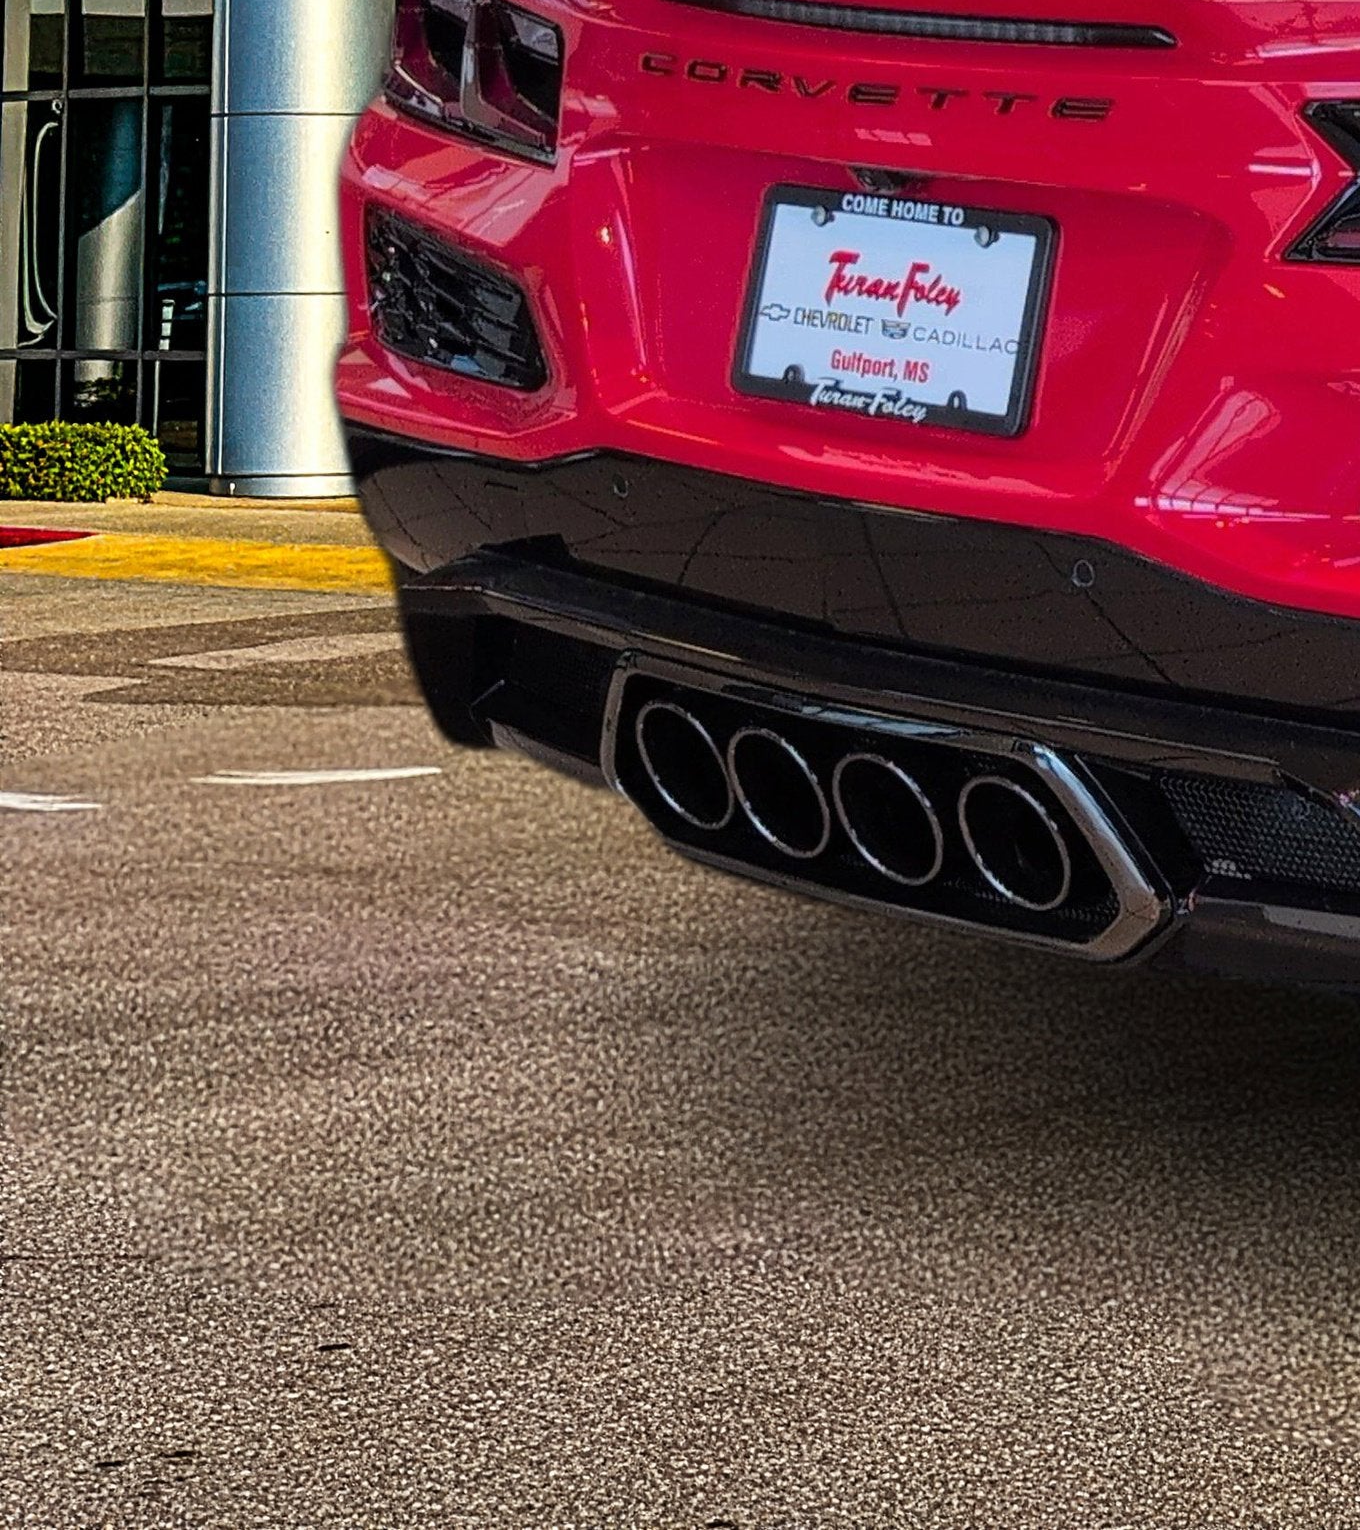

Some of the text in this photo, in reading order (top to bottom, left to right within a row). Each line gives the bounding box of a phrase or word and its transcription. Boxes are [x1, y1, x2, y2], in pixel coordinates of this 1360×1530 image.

[639, 52, 1116, 123] CORVETTE
[842, 193, 965, 226] COME HOME TO
[793, 307, 1022, 355] CHEVROLET CADILLAC
[831, 348, 931, 383] Gulfport, MS
